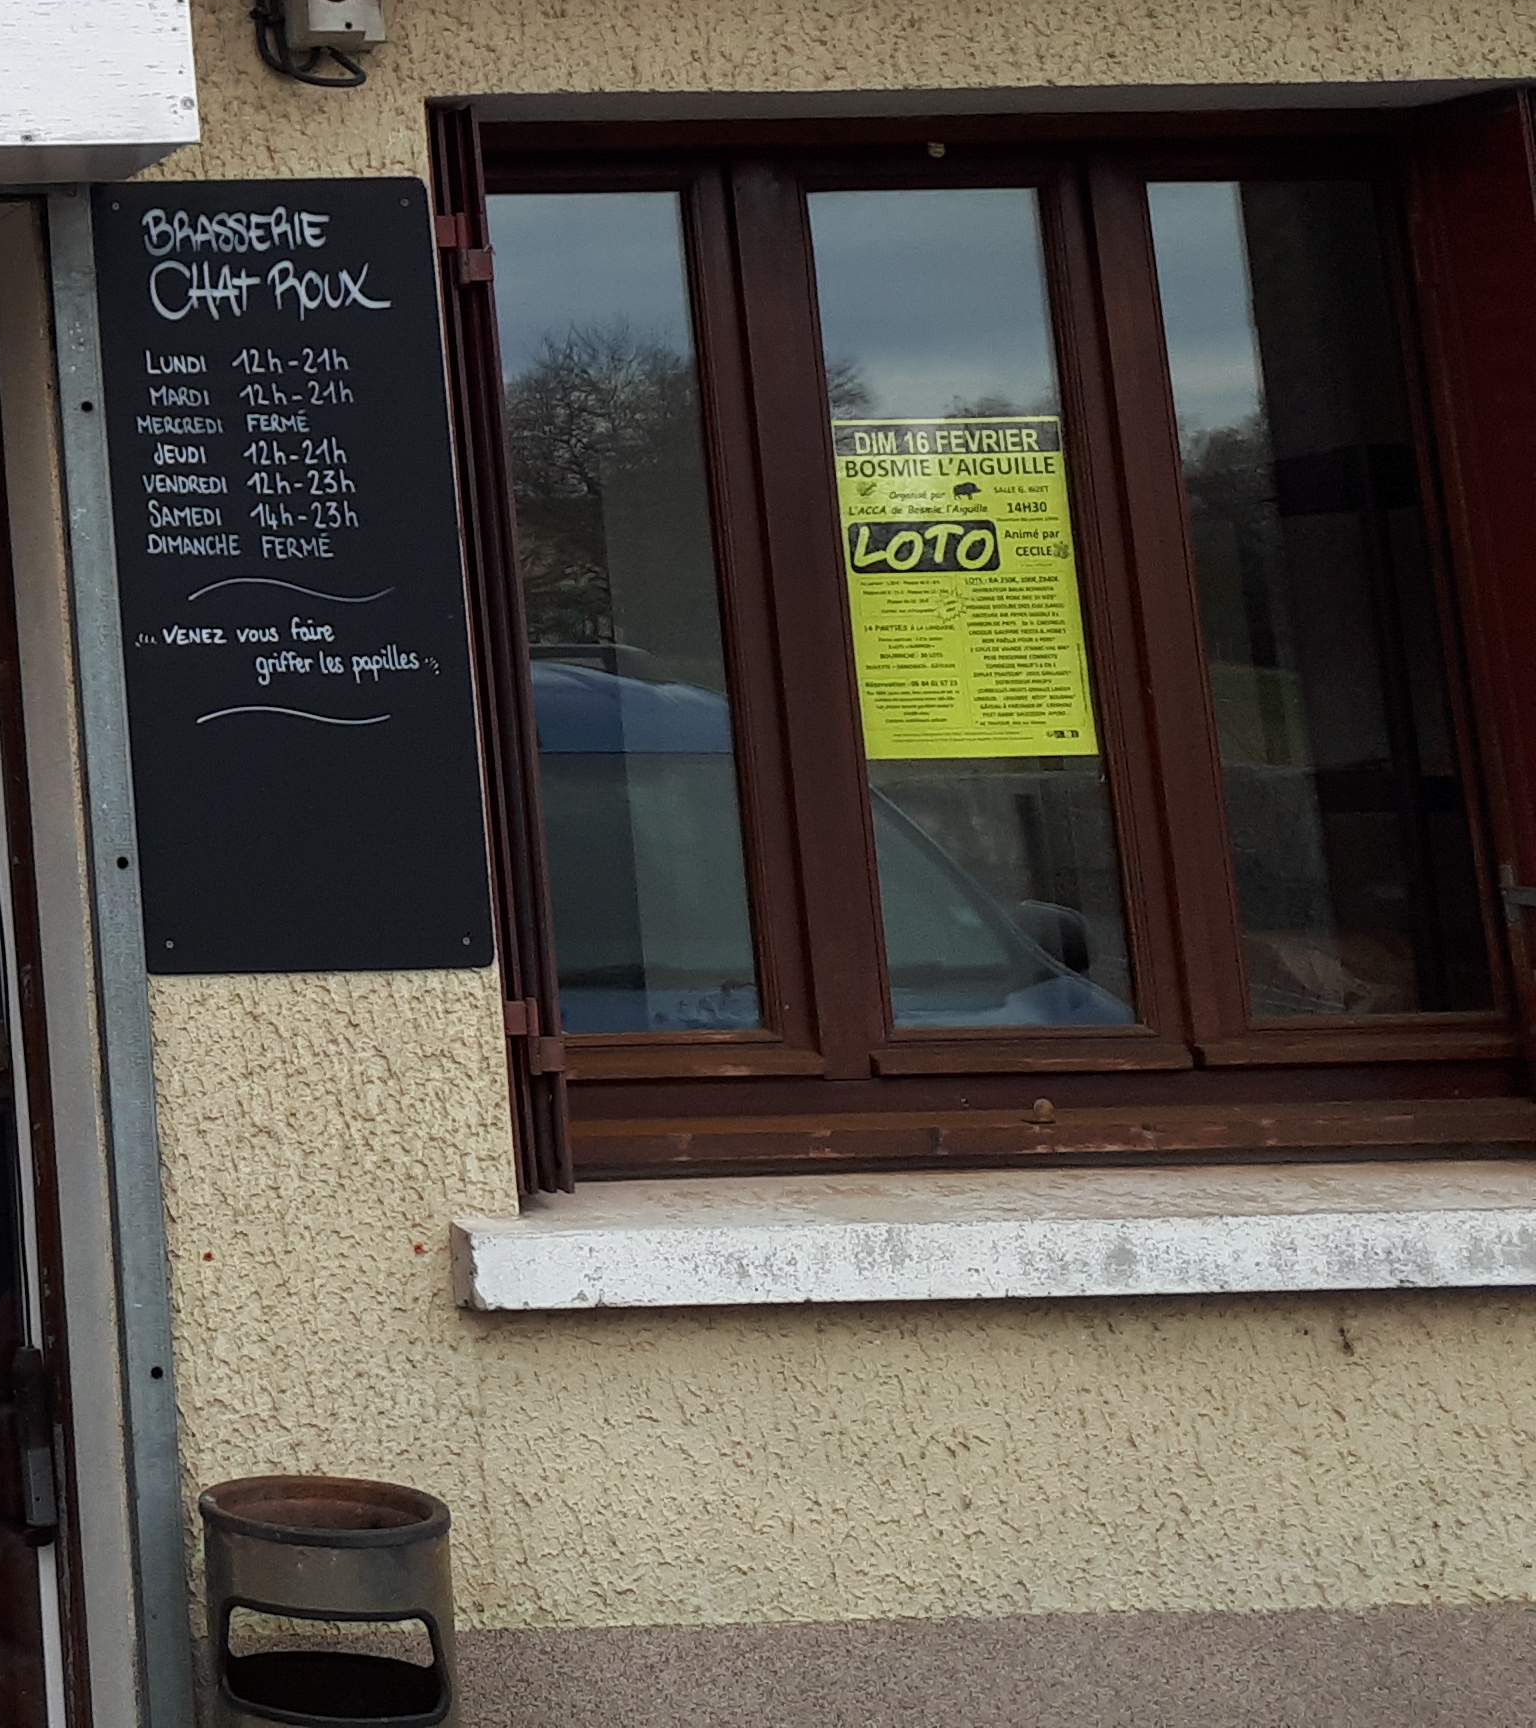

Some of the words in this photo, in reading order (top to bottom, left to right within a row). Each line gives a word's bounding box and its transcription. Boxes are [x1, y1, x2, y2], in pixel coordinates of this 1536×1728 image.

[143, 207, 328, 255] BRASSERIE
[150, 261, 260, 320] CHAT
[268, 261, 391, 320] ROUX
[146, 351, 206, 374] LUNDI
[150, 386, 209, 406] MARDI
[137, 415, 223, 434] MERCREDI
[247, 410, 309, 432] FERMÉ
[854, 432, 898, 454] DIM
[904, 432, 929, 453] 16
[936, 429, 1039, 453] FEVRIER
[154, 443, 206, 465] JEUDI
[845, 458, 930, 478] BOSMIE
[938, 456, 1056, 476] L'AIGUILLE
[143, 474, 227, 493] VENDREDI
[148, 500, 221, 527] SAMEDI
[1007, 501, 1048, 513] 14H30
[148, 534, 240, 555] DIMANCHE
[262, 533, 333, 559] FERMÉ
[1005, 528, 1039, 539] Animé
[1042, 530, 1060, 540] par
[854, 524, 996, 571] LOTO
[1015, 546, 1052, 557] CECILE
[163, 625, 227, 644] VENEZ
[291, 617, 334, 641] faire
[256, 651, 313, 685] griffer
[319, 651, 344, 673] les
[352, 645, 419, 683] papilles
